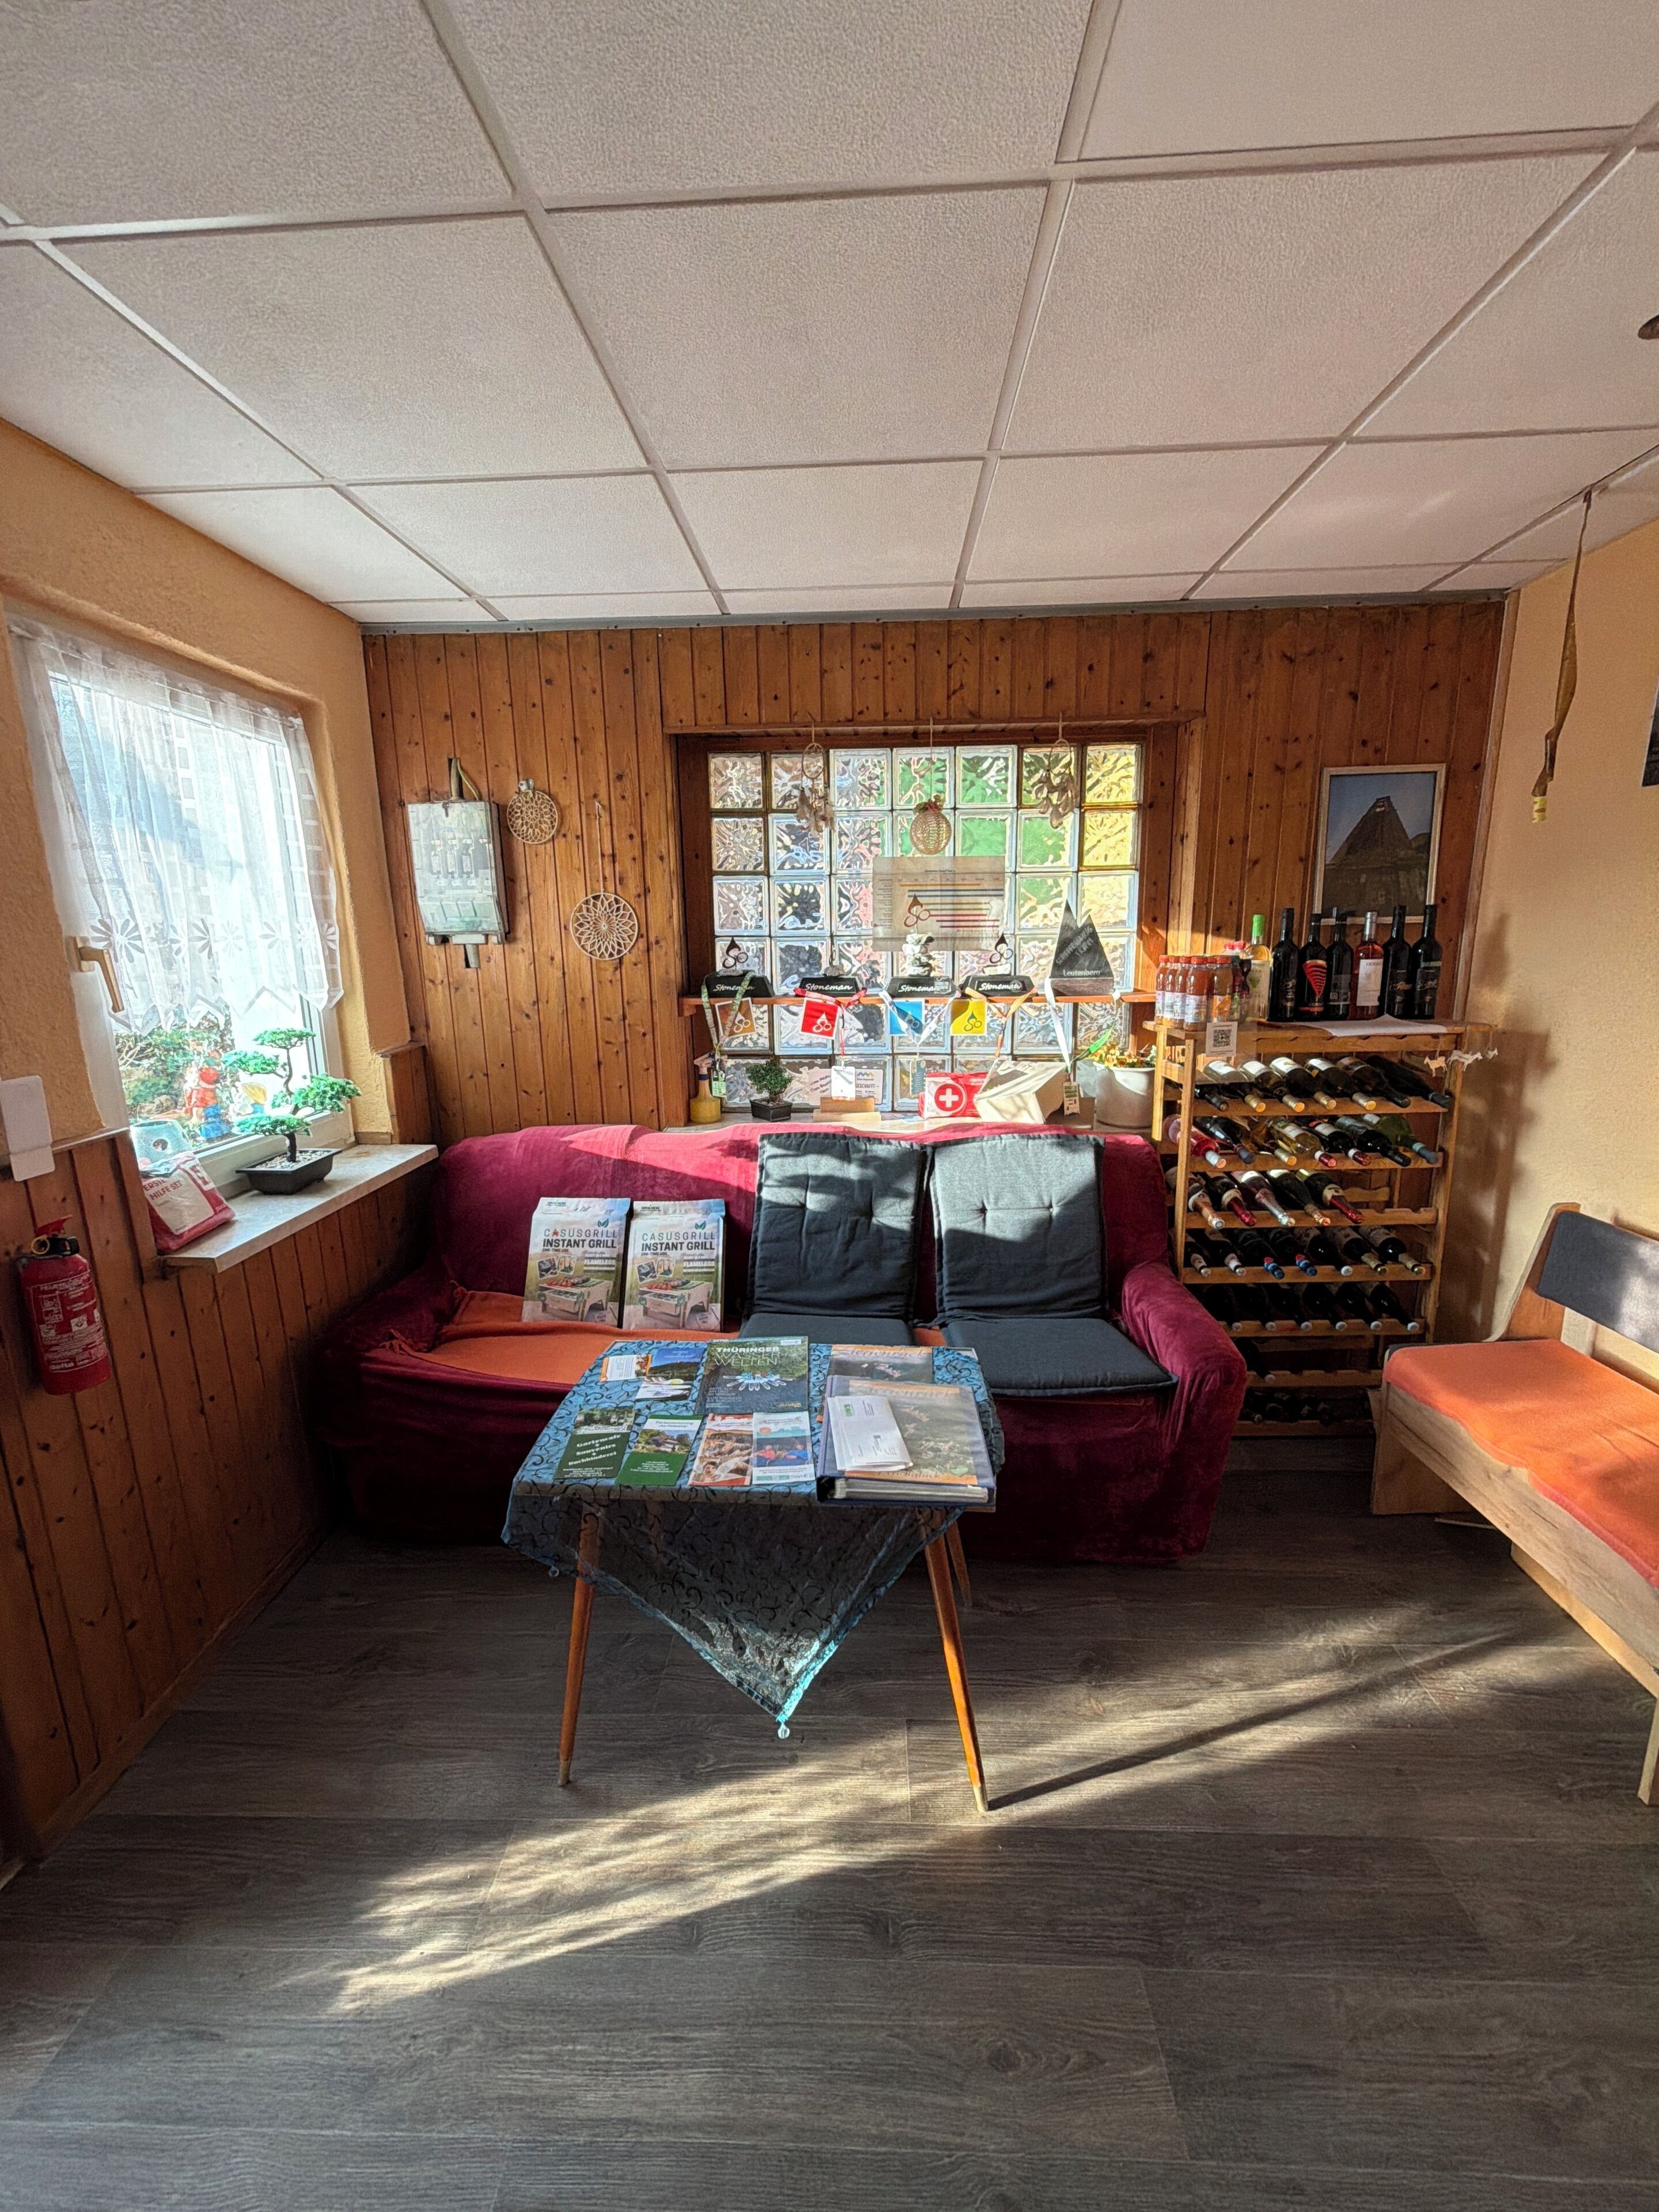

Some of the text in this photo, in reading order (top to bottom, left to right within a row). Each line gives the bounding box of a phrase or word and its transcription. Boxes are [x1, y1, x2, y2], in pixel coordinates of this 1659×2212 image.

[979, 982, 1021, 990] Stoneman
[149, 1180, 183, 1200] HILFE SET
[544, 1228, 618, 1238] CASUSGRILL
[642, 1232, 715, 1241] CASUSGRILL
[543, 1238, 616, 1248] INSTANT GRILL
[641, 1241, 715, 1251] INSTANT GRILL
[714, 1358, 778, 1366] WELTEN
